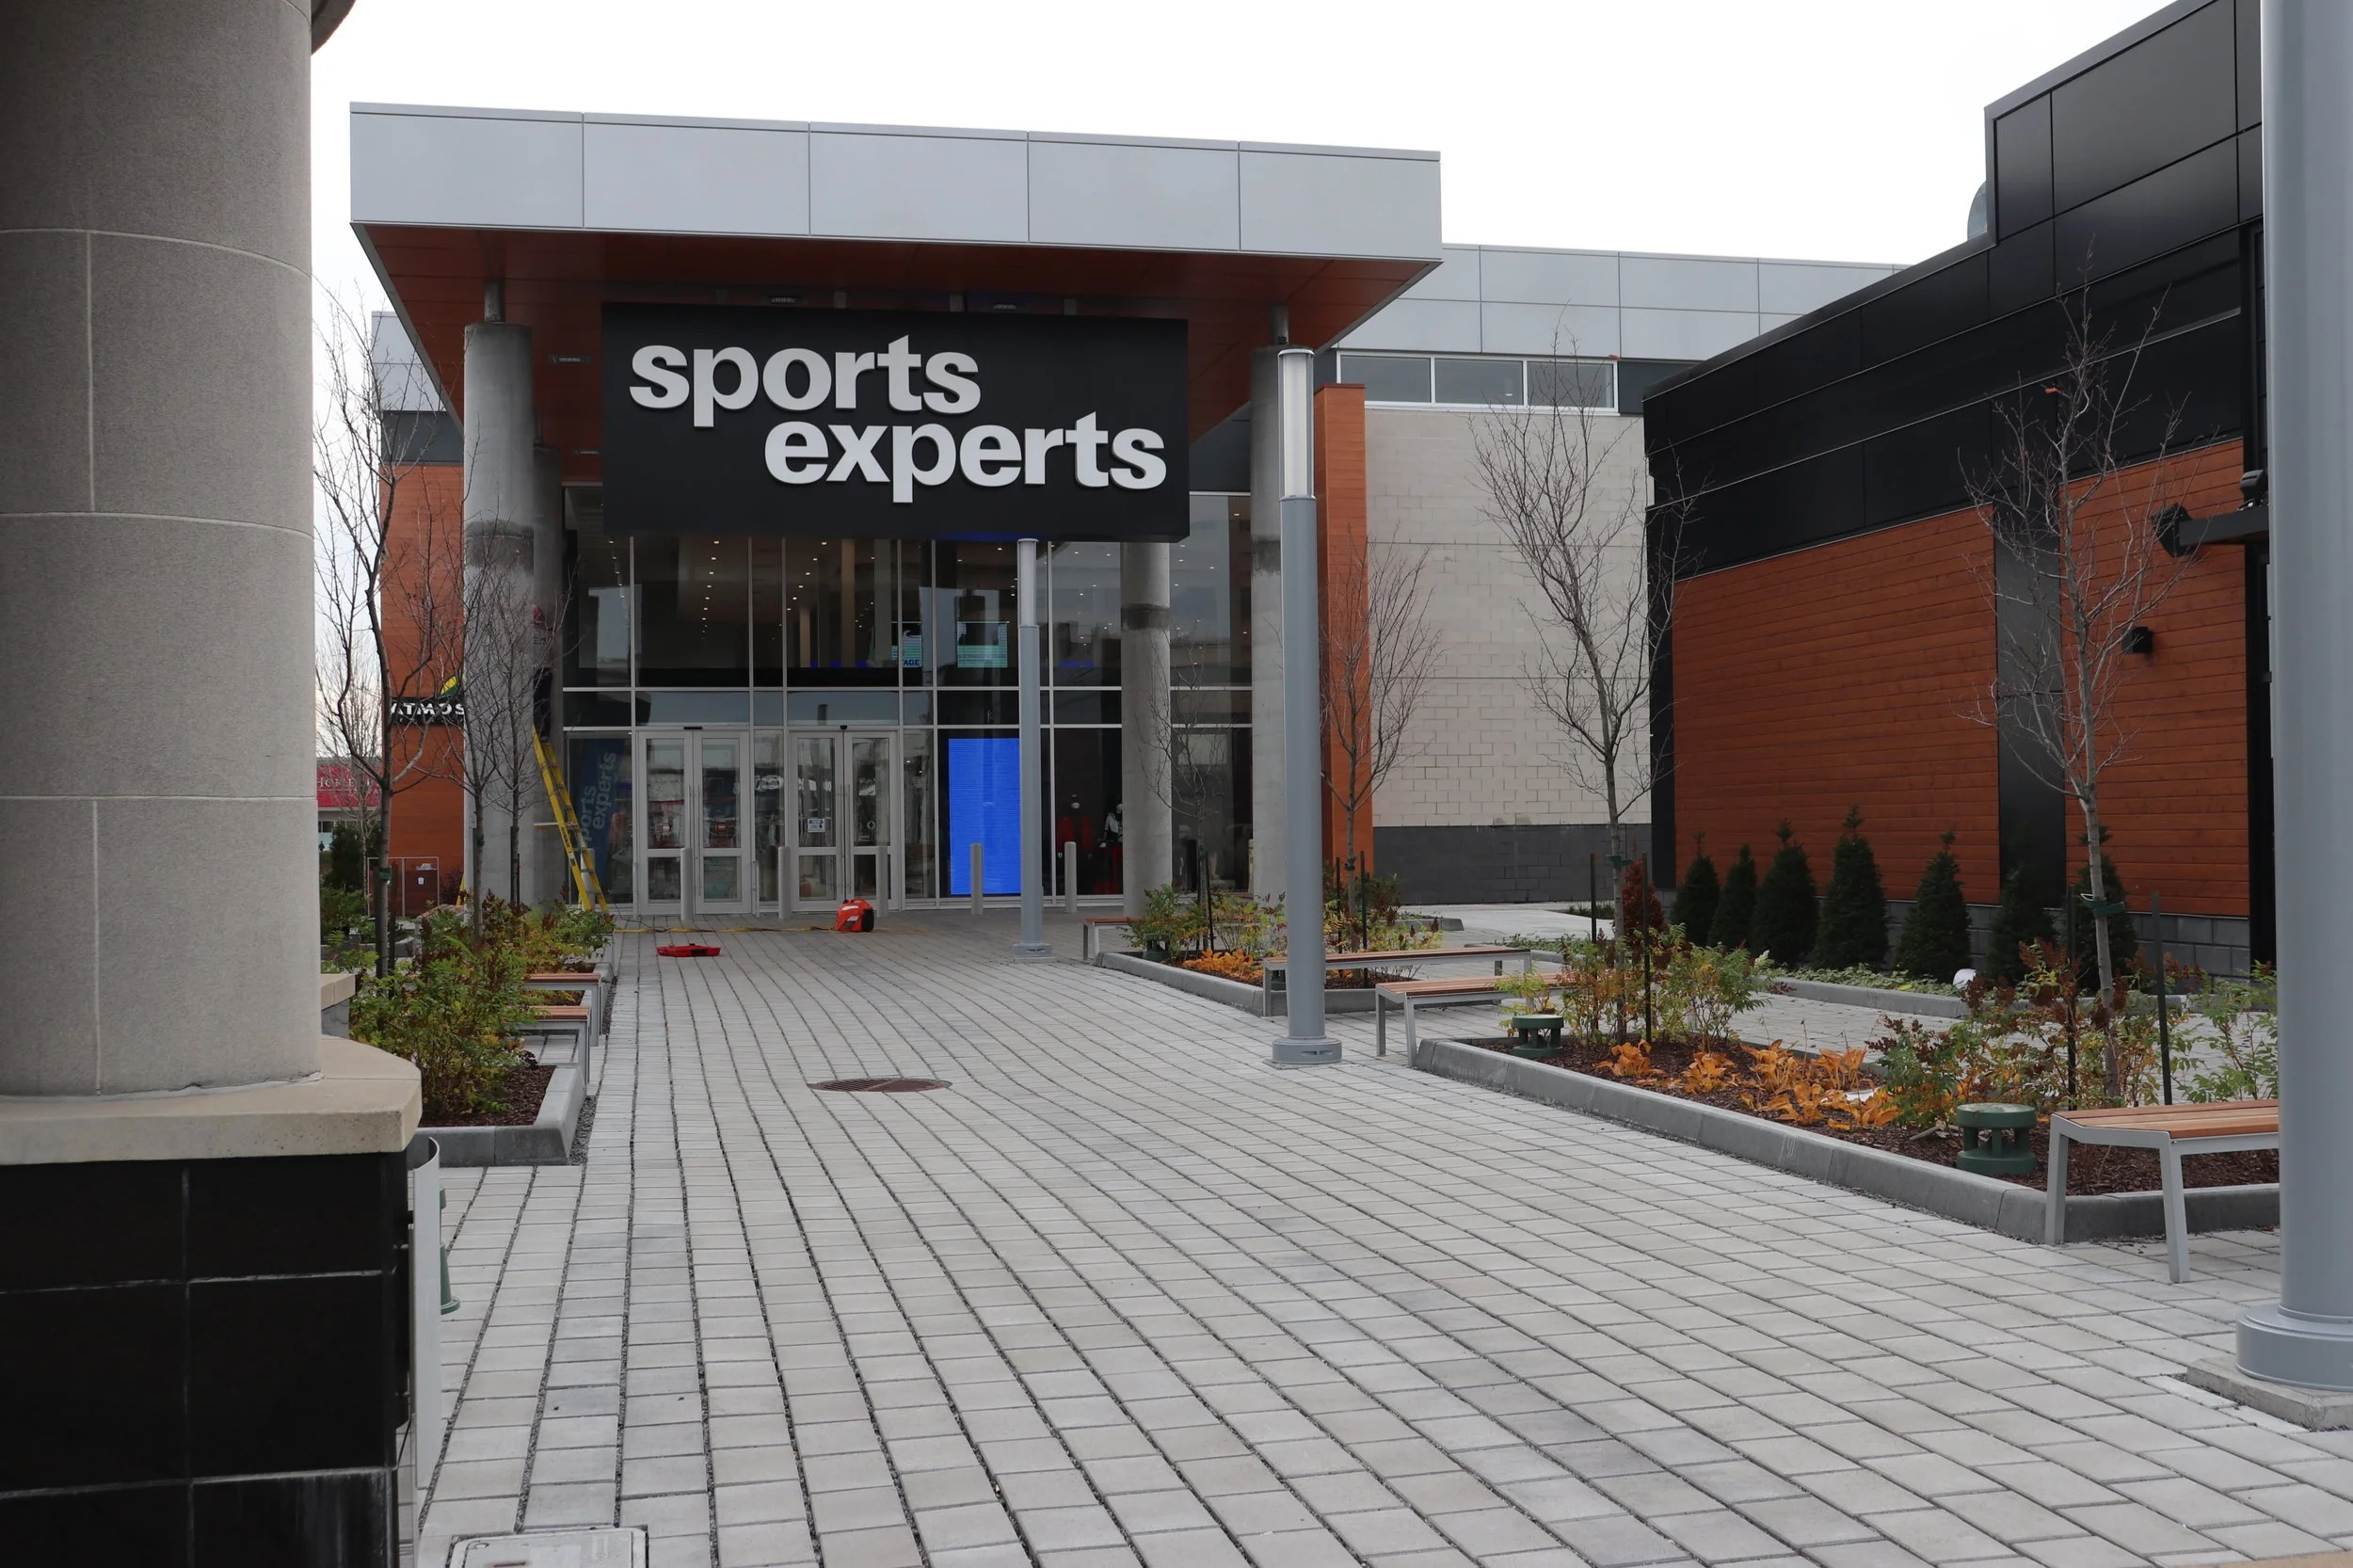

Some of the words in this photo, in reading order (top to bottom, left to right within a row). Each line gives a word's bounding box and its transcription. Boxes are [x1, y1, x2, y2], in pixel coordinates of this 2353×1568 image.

[629, 334, 982, 427] sports
[764, 411, 1167, 504] experts
[581, 786, 597, 843] ports
[593, 752, 617, 829] experts
